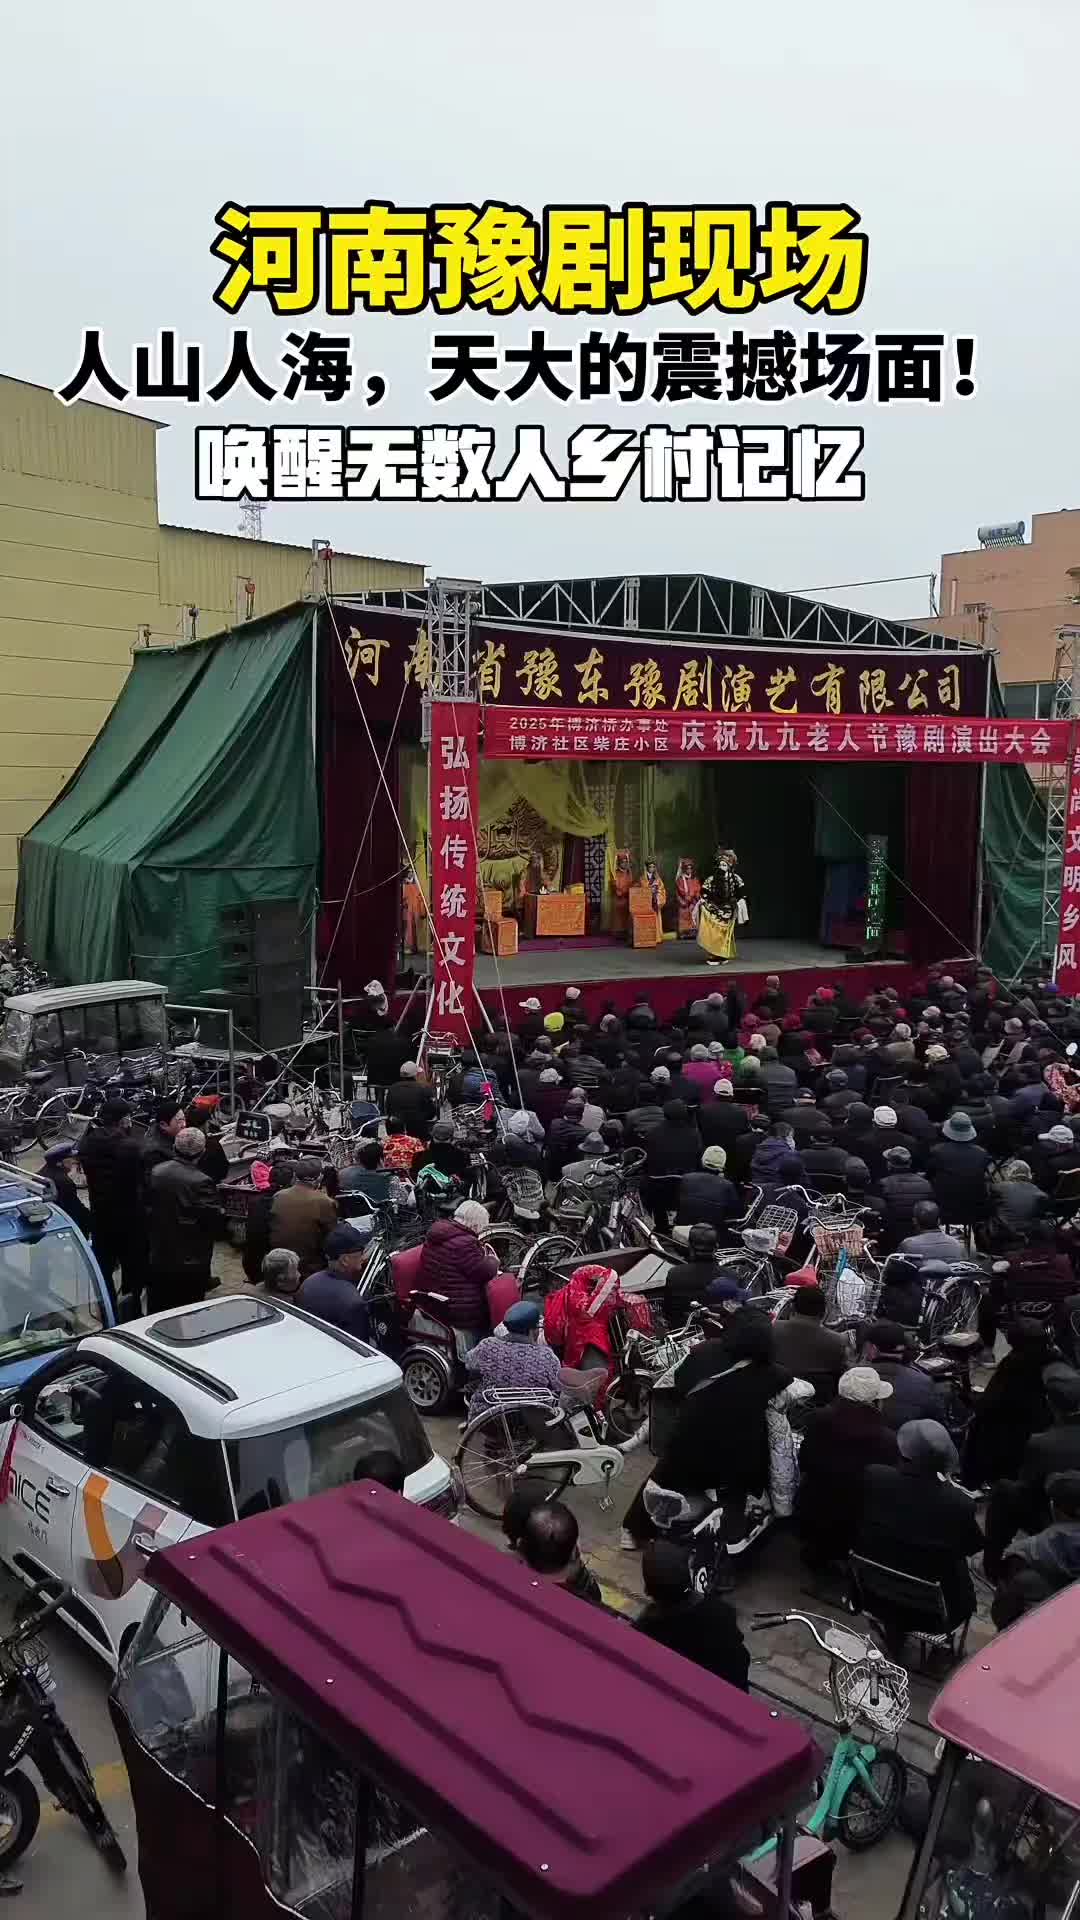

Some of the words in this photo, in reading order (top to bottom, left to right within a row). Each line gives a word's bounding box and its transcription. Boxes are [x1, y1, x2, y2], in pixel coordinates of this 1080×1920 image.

[509, 716, 669, 732] 2025年博济桥办事处
[680, 719, 1051, 755] 庆祝九九老人节豫剧演出大会
[509, 735, 669, 751] 博济社区柴庄小区
[437, 736, 471, 1016] 弘扬传统文化
